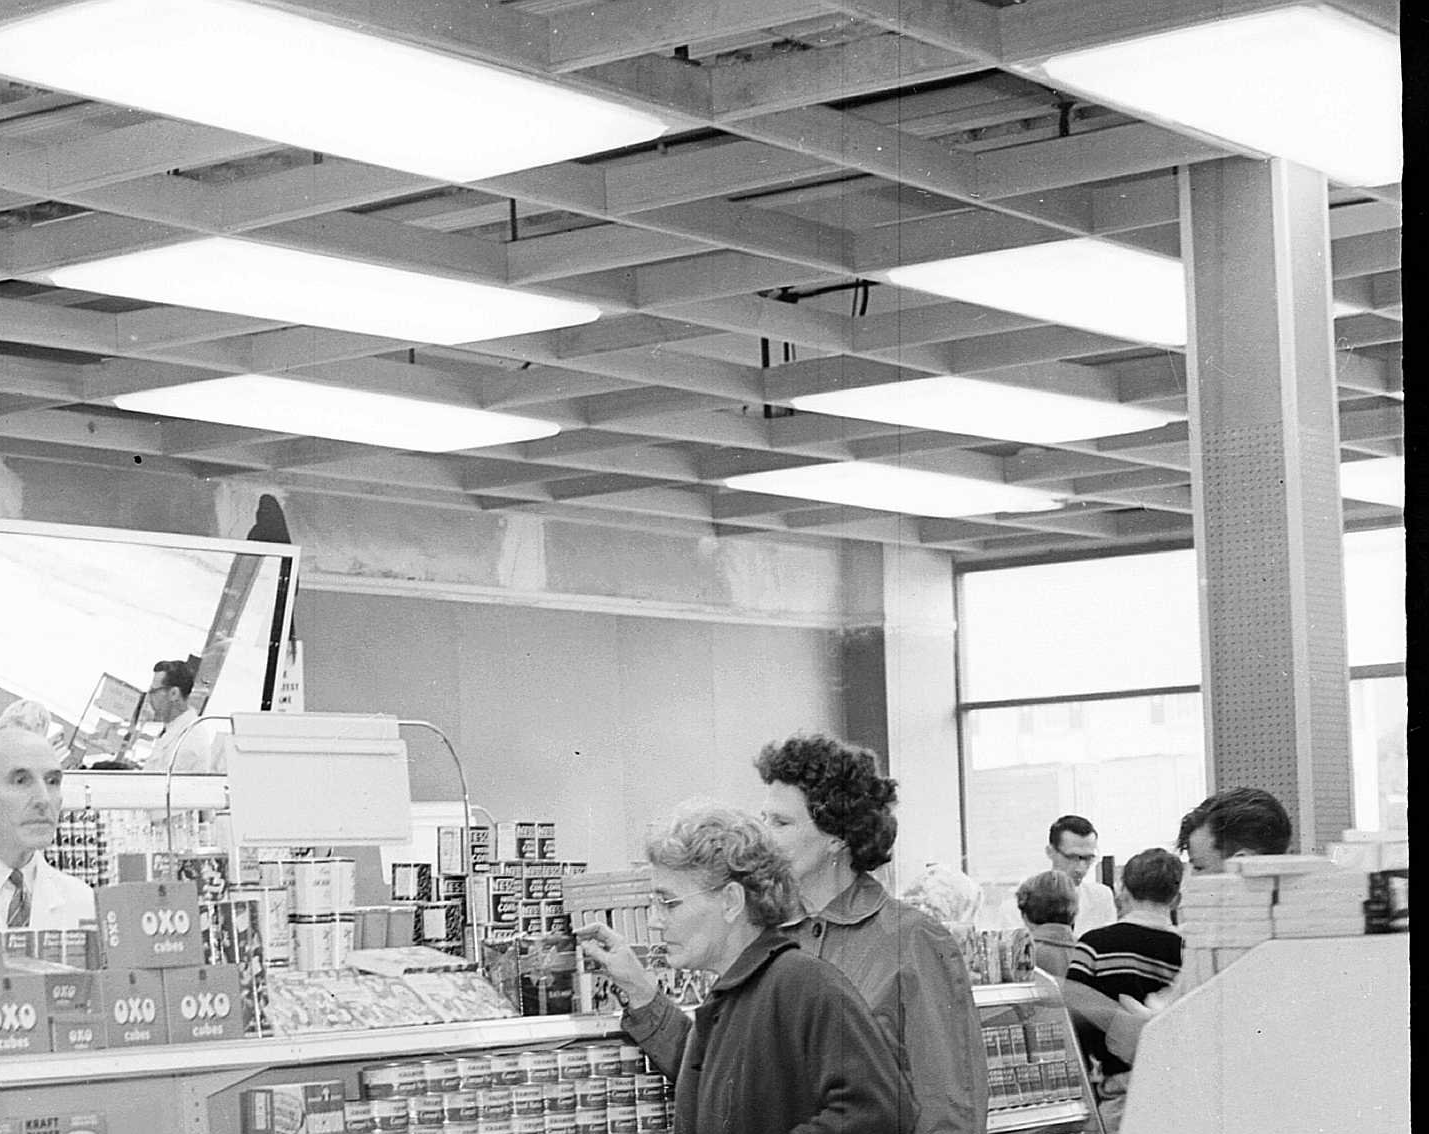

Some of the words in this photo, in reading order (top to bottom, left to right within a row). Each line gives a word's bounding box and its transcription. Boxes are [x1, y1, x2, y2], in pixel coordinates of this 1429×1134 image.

[107, 910, 120, 948] OXO
[142, 909, 190, 936] OXO
[154, 939, 184, 954] cubes
[53, 985, 77, 999] OXO
[114, 997, 156, 1025] OXO
[181, 992, 231, 1020] OXO
[69, 1028, 93, 1043] OXO
[124, 1028, 151, 1042] cubes
[192, 1022, 224, 1038] cubes
[26, 1117, 59, 1129] KRAFT
